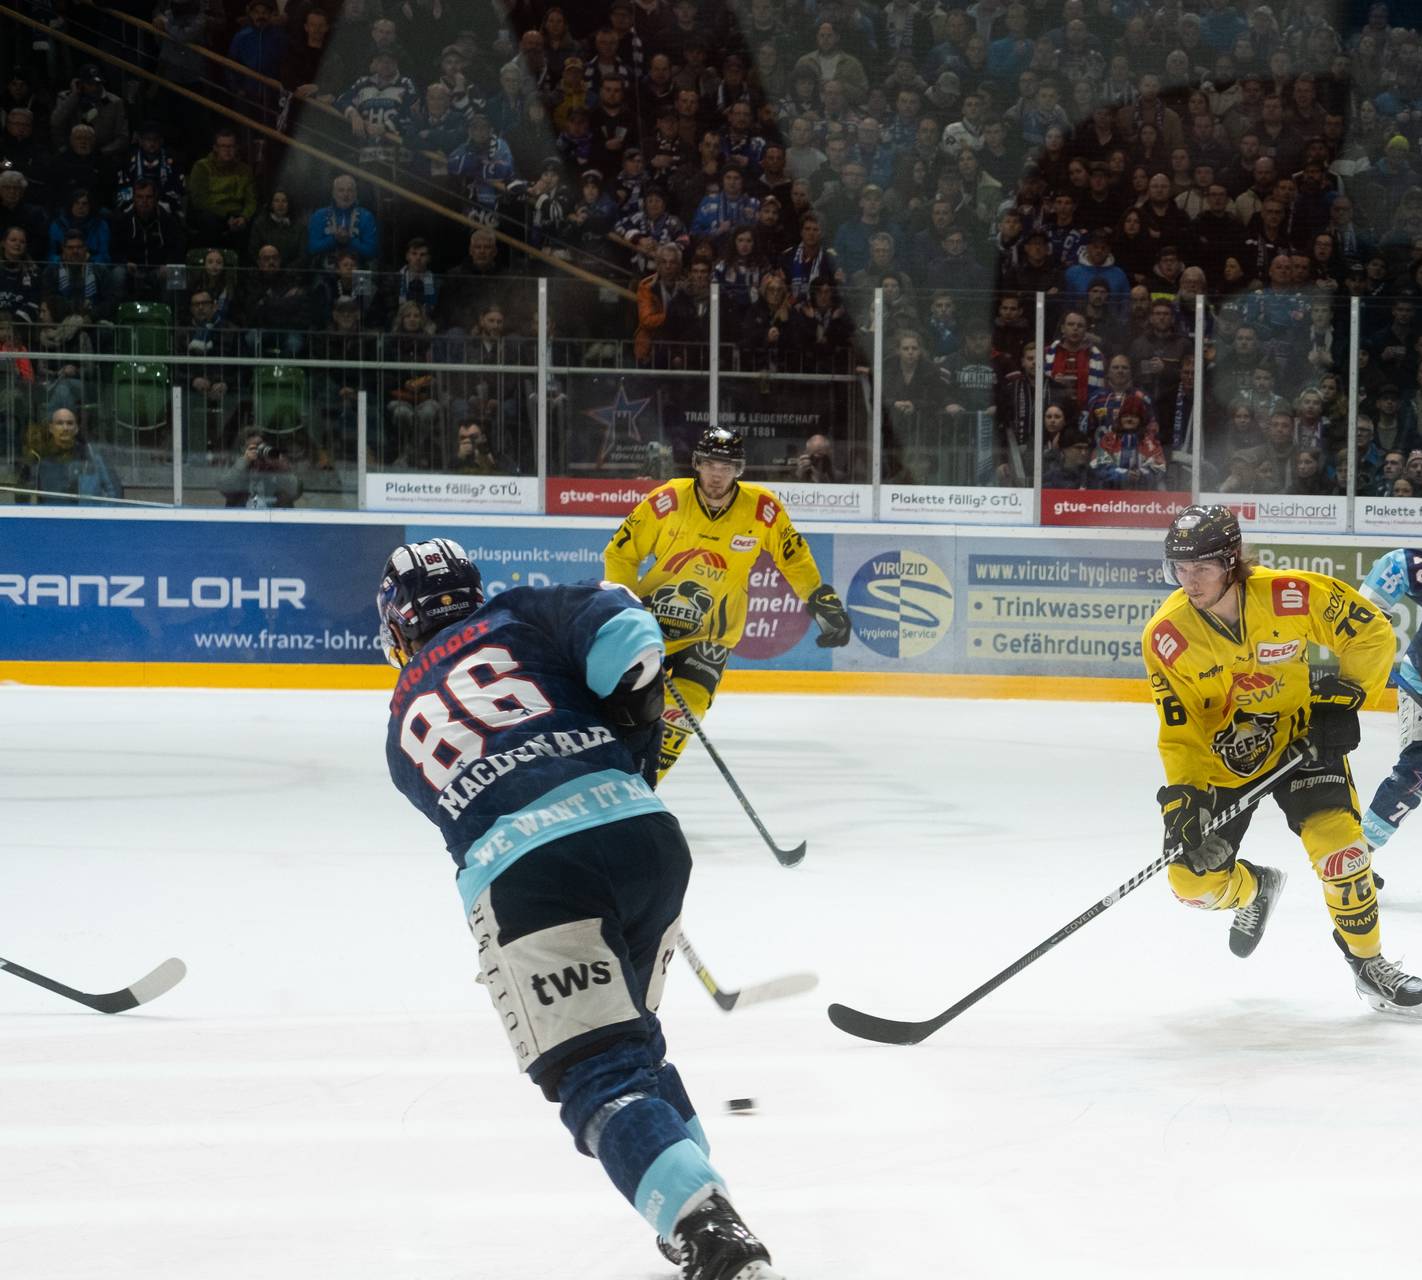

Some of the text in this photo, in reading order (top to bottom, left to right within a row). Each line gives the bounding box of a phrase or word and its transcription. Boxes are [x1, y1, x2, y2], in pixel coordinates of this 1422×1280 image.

[685, 411, 736, 424] TRADION
[385, 481, 522, 497] Plakette fällig? GTÜ.
[560, 487, 650, 506] gtue-neidha
[778, 490, 860, 507] Neidhardt
[891, 492, 1022, 509] Plakette fällig? GTÜ.
[1053, 500, 1184, 515] gtue-neidhardt.de
[1258, 503, 1337, 518] Neidhardt
[1365, 504, 1416, 517] Plakette
[611, 525, 632, 549] 7
[693, 562, 722, 583] SW
[749, 567, 781, 588] eit
[873, 561, 928, 577] VIRUZID
[975, 561, 1165, 587] www.viruzid-hygiene-se
[158, 576, 306, 609] LOHR
[651, 602, 704, 621] KREFEL
[993, 596, 1162, 625] Trinkwasserprü
[1335, 600, 1376, 638] 76
[658, 615, 695, 630] PINGUINE
[744, 617, 778, 638] ch!
[859, 627, 937, 642] Hygiene Service
[993, 633, 1144, 662] Gefährdungsa
[1235, 673, 1285, 708] SWK
[400, 646, 552, 792] 86
[1155, 696, 1187, 727] 6
[438, 726, 617, 821] MACDONALD
[1290, 774, 1346, 794] Borgmann
[474, 776, 655, 867] WE WANT IT AL
[1335, 874, 1372, 906] 76
[531, 959, 613, 1007] tws
